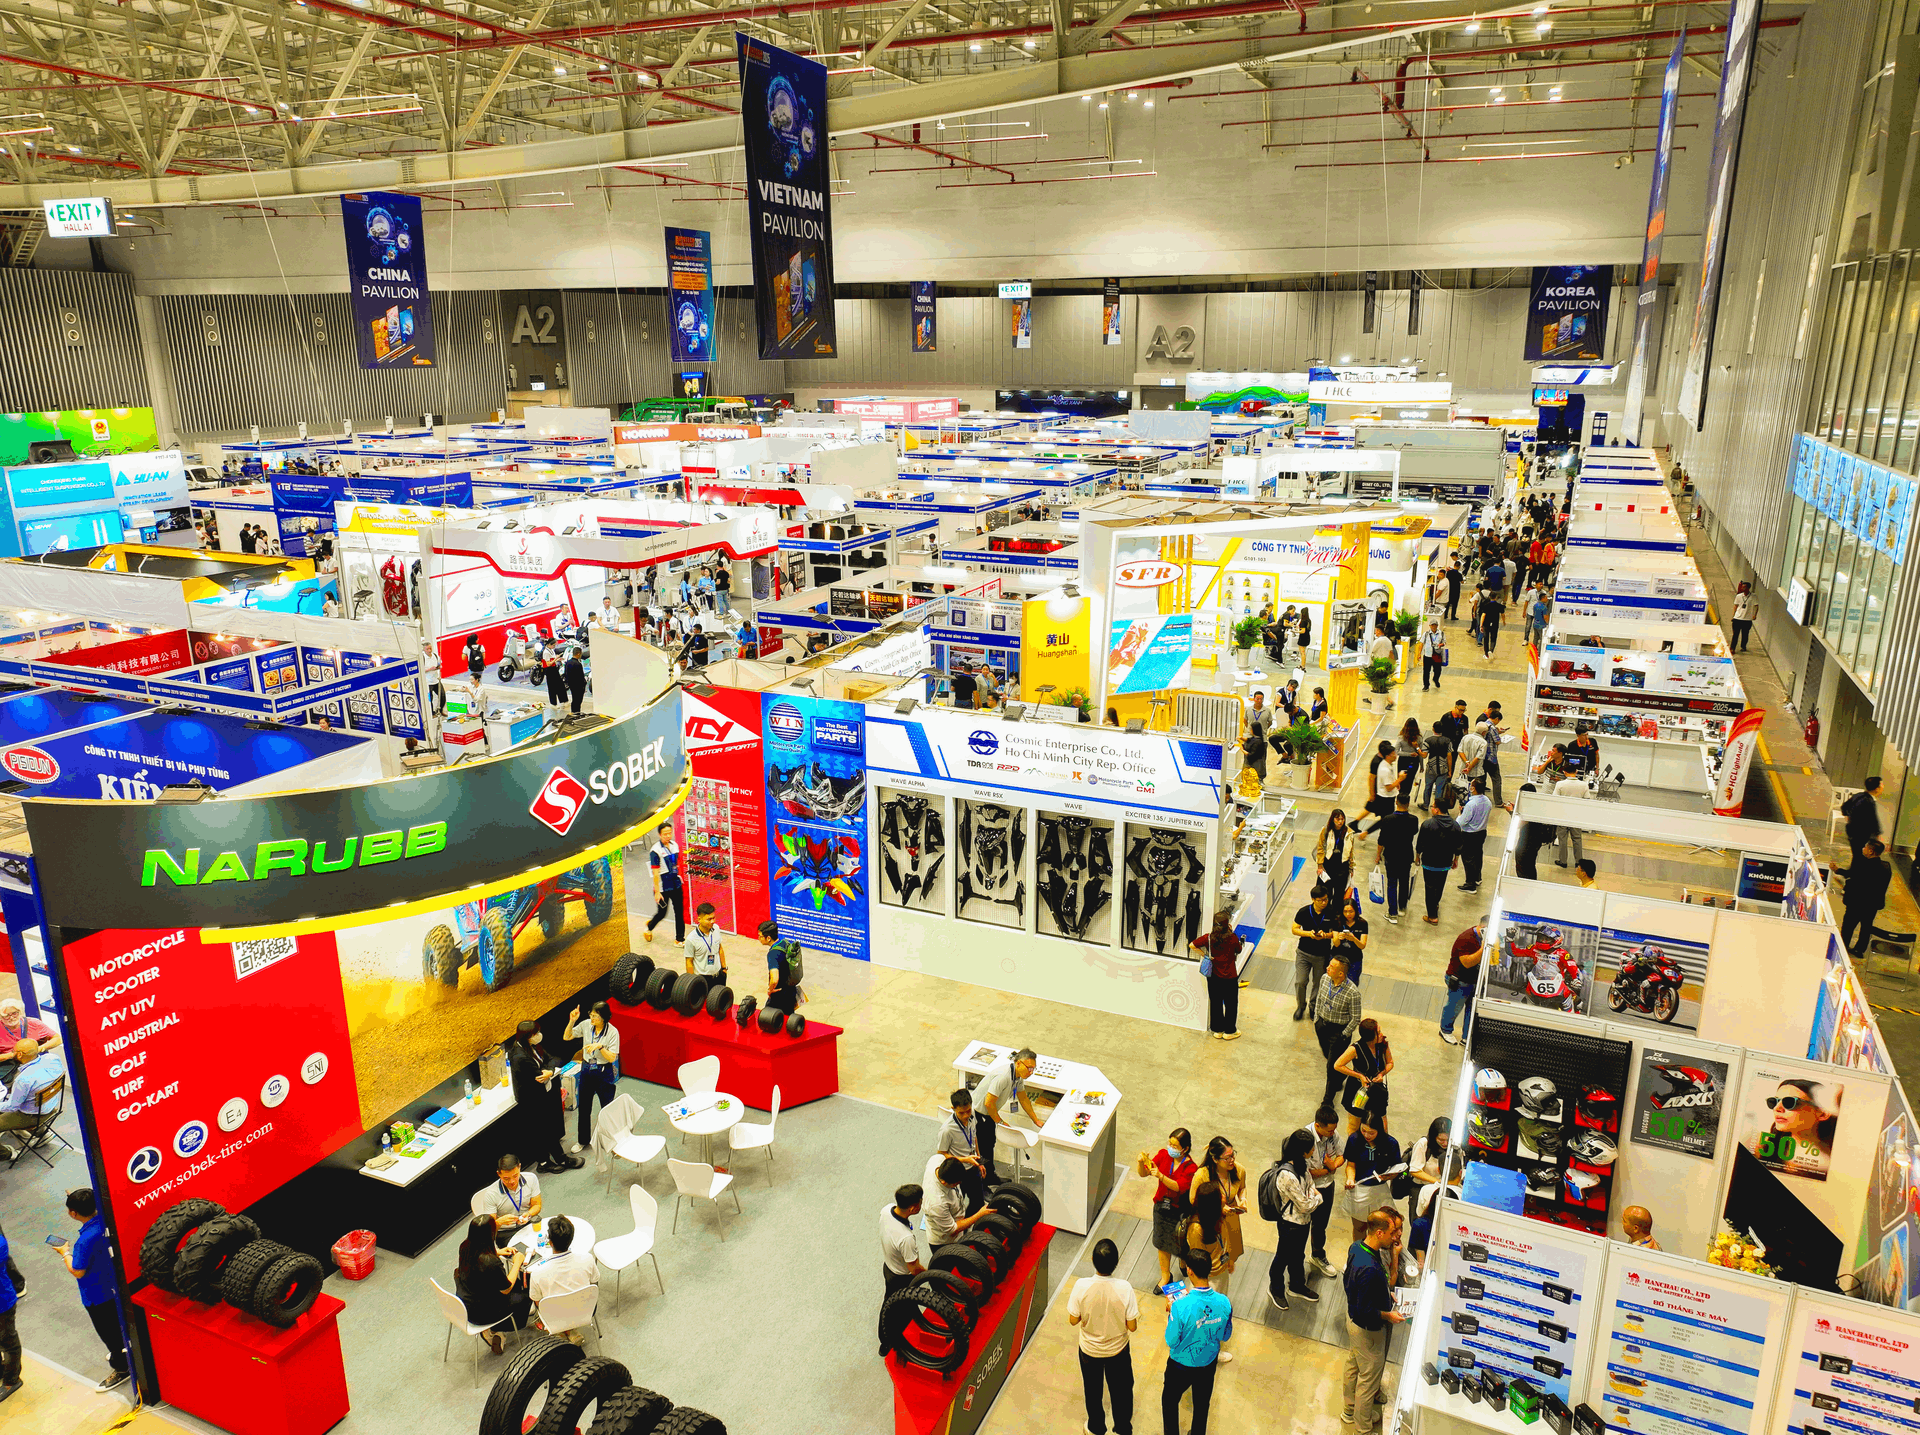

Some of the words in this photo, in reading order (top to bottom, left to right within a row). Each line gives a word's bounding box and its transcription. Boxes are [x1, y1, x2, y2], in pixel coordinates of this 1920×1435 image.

[758, 179, 824, 212] VIETNAM
[57, 203, 92, 222] EXIT
[63, 223, 82, 232] HALL
[84, 222, 93, 231] A1
[762, 212, 824, 241] PAVILION
[368, 267, 411, 282] CHINA
[362, 285, 419, 300] PAVILION
[1545, 286, 1596, 297] KOREA
[916, 294, 932, 304] CHINA
[1538, 300, 1601, 310] PAVILION
[914, 304, 934, 314] PAVILION
[511, 304, 558, 344] A2
[1145, 324, 1196, 360] A2
[621, 427, 670, 441] HORWIN
[697, 427, 749, 441] HORWIN
[1252, 541, 1274, 552] CÔNG
[1277, 543, 1287, 553] TY
[1119, 567, 1171, 581] SFR
[1046, 633, 1070, 648] 黄山
[1037, 647, 1077, 660] Huangshan
[131, 665, 163, 675] TECHNOLOGY
[335, 683, 352, 693] FACTORY
[1713, 702, 1729, 712] 2025
[770, 716, 803, 728] WIN
[815, 726, 857, 736] MOTORCYCLE
[816, 731, 857, 744] PARTS
[695, 747, 723, 757] MOTOR
[724, 742, 758, 753] SPORTS
[1005, 733, 1042, 747] Cosmic
[1045, 738, 1097, 754] Enterprise
[1100, 745, 1122, 757] Co.,
[1125, 748, 1144, 759] Ltd.
[84, 744, 107, 757] CÔNG
[107, 748, 117, 759] TY
[118, 751, 140, 763] TNHH
[141, 751, 163, 767] THIẾT
[165, 760, 175, 772] BỊ
[176, 760, 187, 772] VÀ
[188, 763, 206, 778] PHỤ
[207, 765, 230, 780] TÙNG
[967, 759, 982, 769] TDR
[1005, 747, 1020, 757] Ho
[1023, 749, 1041, 760] Chi
[1043, 752, 1070, 764] Minh
[1073, 755, 1094, 769] City
[1096, 758, 1120, 772] Rep.
[1123, 761, 1156, 775] Office
[588, 735, 667, 806] SOBEK
[996, 763, 1020, 772] RPD
[890, 777, 907, 785] WAVE
[908, 779, 926, 788] ALPHA
[740, 788, 753, 796] NCY
[974, 789, 989, 797] WAVE
[990, 791, 1004, 799] RSX
[1136, 785, 1155, 794] CMI
[1064, 802, 1083, 811] WAVE
[1125, 810, 1151, 820] EXCITER
[1168, 817, 1192, 826] JUPITER
[1193, 820, 1204, 828] MX
[140, 820, 449, 888] NARUBB
[1748, 872, 1775, 881] KHÔNG
[89, 929, 186, 981] MOTORCYCLE
[94, 966, 161, 1004] SCOOTER
[1537, 982, 1556, 994] 65
[100, 1004, 128, 1031] ATV
[130, 995, 156, 1018] UTV
[103, 1012, 180, 1056] INDUSTRIAL
[108, 1051, 147, 1079] GOLF
[307, 1060, 324, 1077] SNI
[112, 1076, 145, 1101] TURF
[116, 1080, 180, 1122] GO-KART
[1661, 1091, 1715, 1109] AXXIS
[1682, 1135, 1706, 1147] HELMET
[133, 1121, 274, 1209] www.sobek-tire.com
[1519, 1242, 1533, 1251] LTD
[1695, 1290, 1711, 1300] LTD
[1623, 1302, 1640, 1311] Model:
[1696, 1310, 1706, 1318] XE
[1708, 1313, 1729, 1323] MÁY
[1697, 1321, 1710, 1329] CÔNG
[1618, 1334, 1637, 1343] Model:
[1892, 1340, 1909, 1349] LTD
[1692, 1353, 1705, 1361] CÔNG
[976, 1338, 1004, 1390] SOBEK
[1613, 1365, 1631, 1374] Model:
[1687, 1384, 1700, 1393] CÔNG
[1609, 1396, 1627, 1405] Model:
[1682, 1416, 1695, 1424] CÔNG
